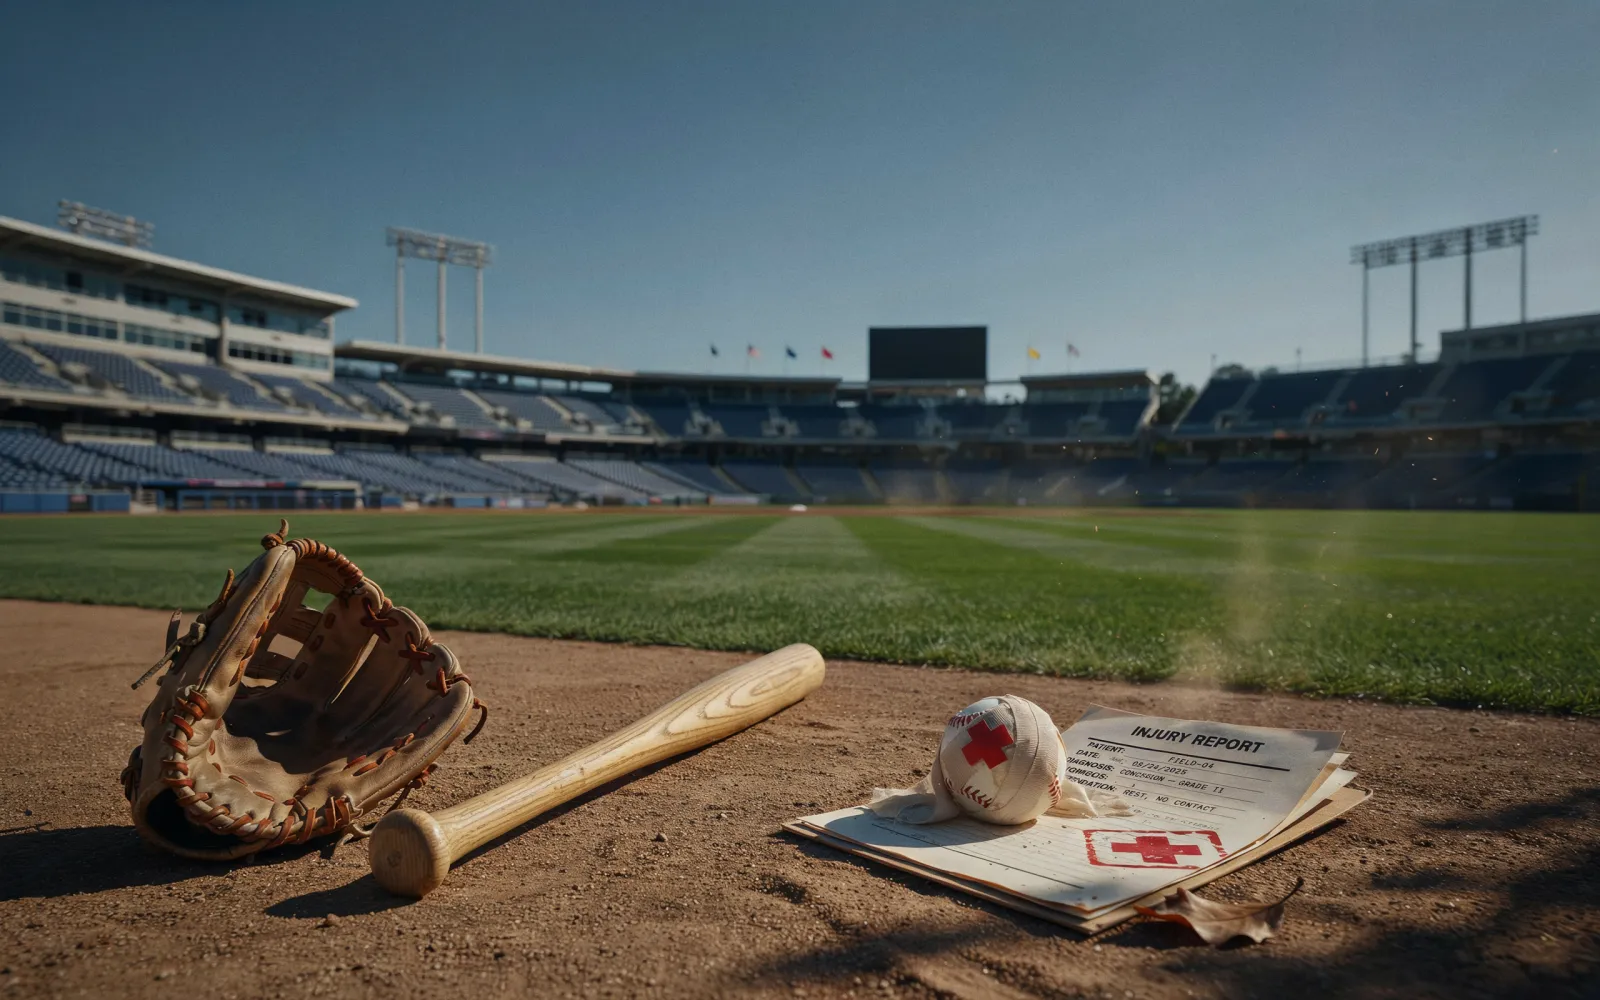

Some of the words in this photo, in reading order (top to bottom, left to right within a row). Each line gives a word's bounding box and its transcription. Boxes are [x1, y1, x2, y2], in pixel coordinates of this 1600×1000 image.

[1131, 726, 1191, 743] INJURY
[1191, 734, 1265, 753] REPORT
[1087, 741, 1125, 753] PATIENT:
[1075, 749, 1100, 759] DATE:
[1178, 780, 1209, 791] GRADE
[1122, 789, 1148, 800] REST,
[1155, 795, 1169, 803] NO
[1173, 799, 1217, 813] CONTACT
